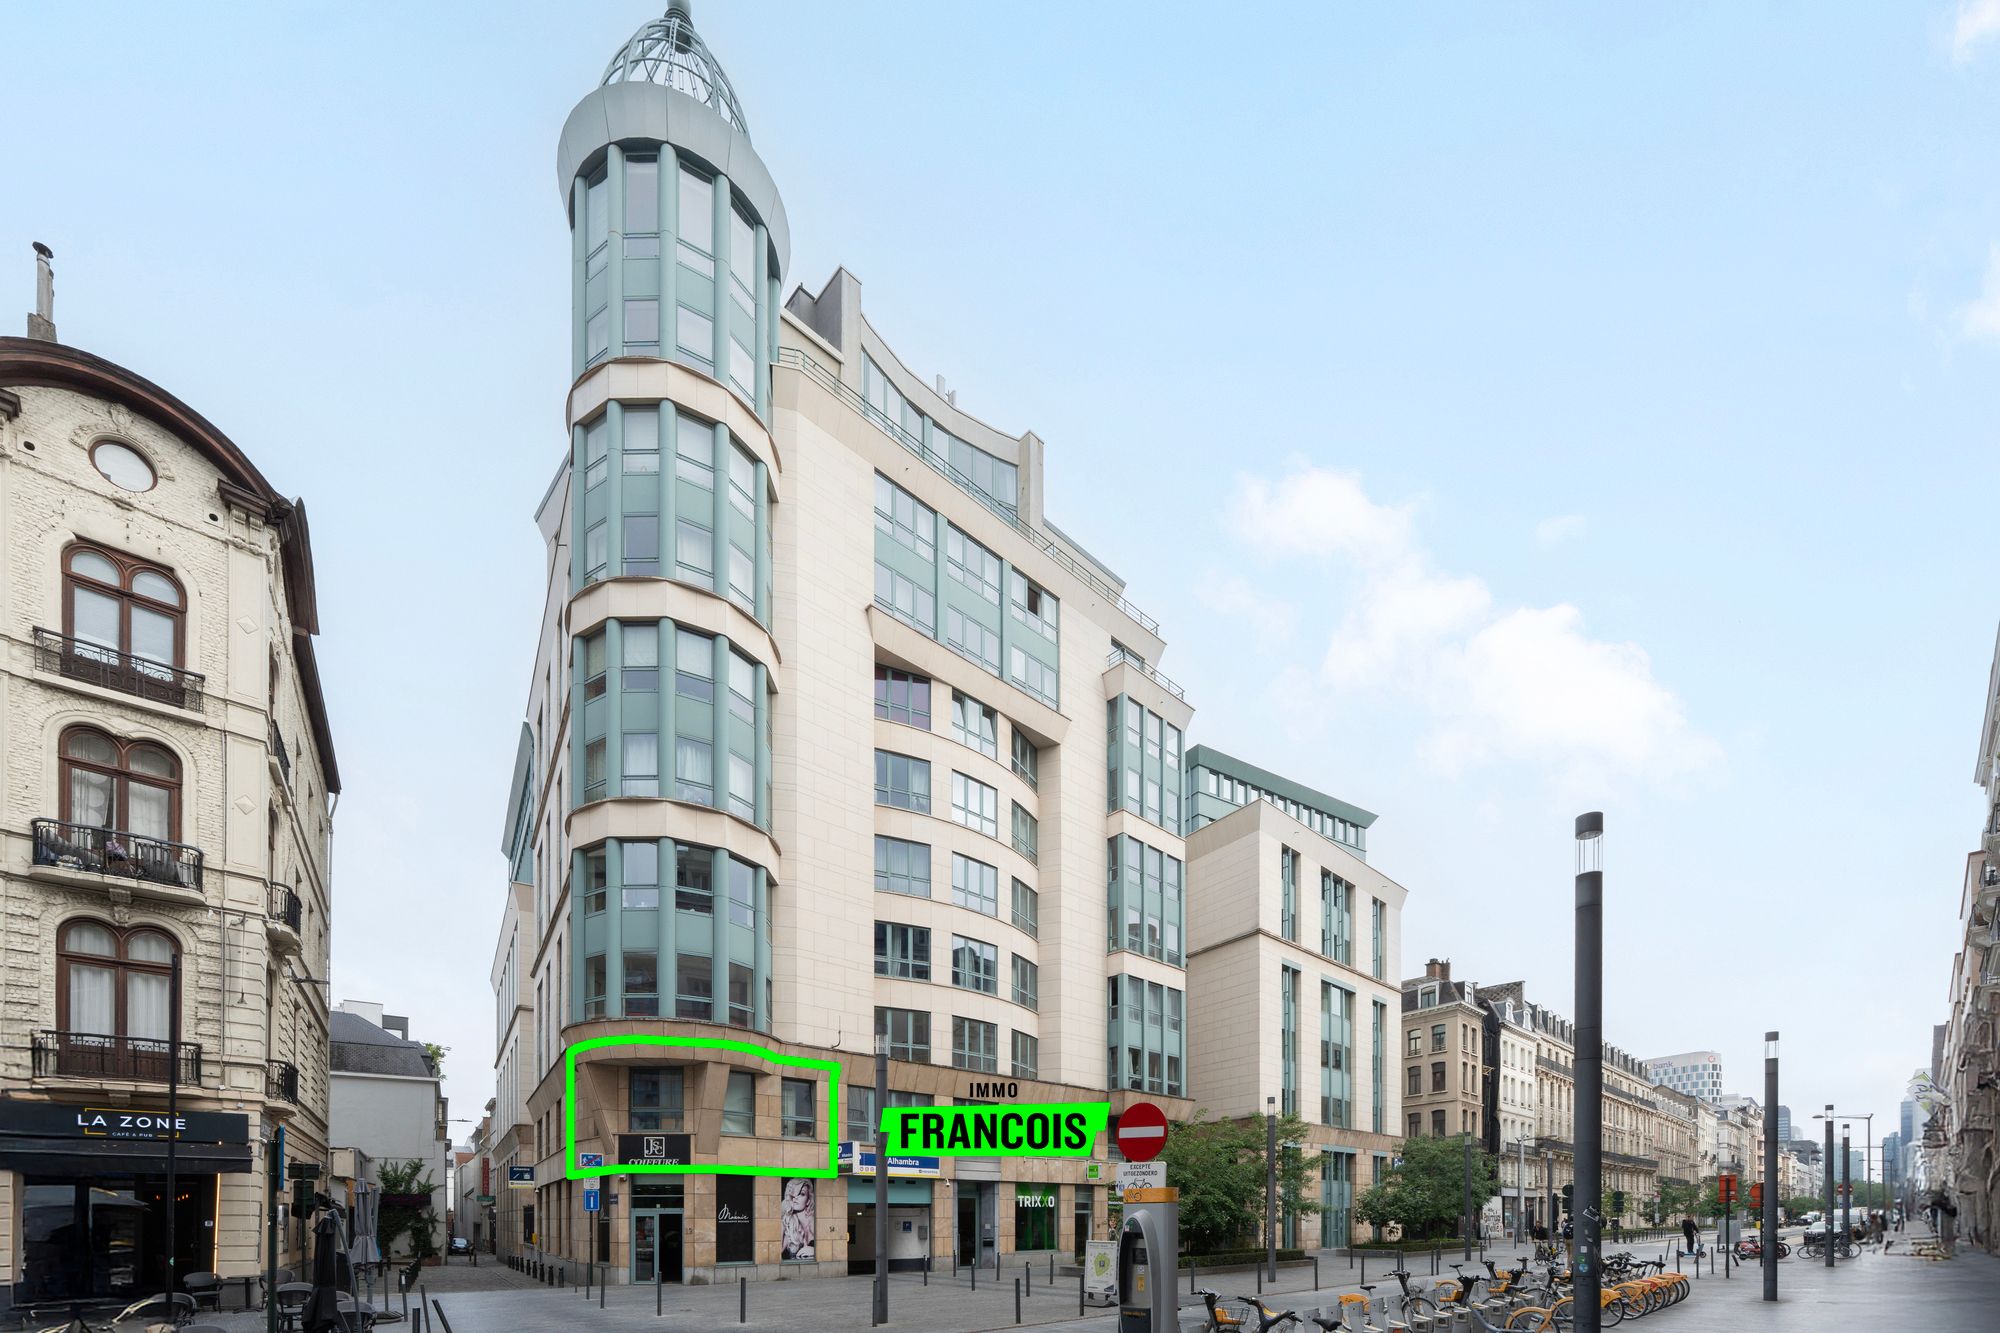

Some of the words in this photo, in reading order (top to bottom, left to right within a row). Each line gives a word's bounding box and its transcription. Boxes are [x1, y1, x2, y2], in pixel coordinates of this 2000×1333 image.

[77, 1114, 107, 1126] LA
[120, 1116, 186, 1129] ZONE
[887, 1157, 919, 1166] Alhambra
[1017, 1196, 1055, 1207] TRIXXO
